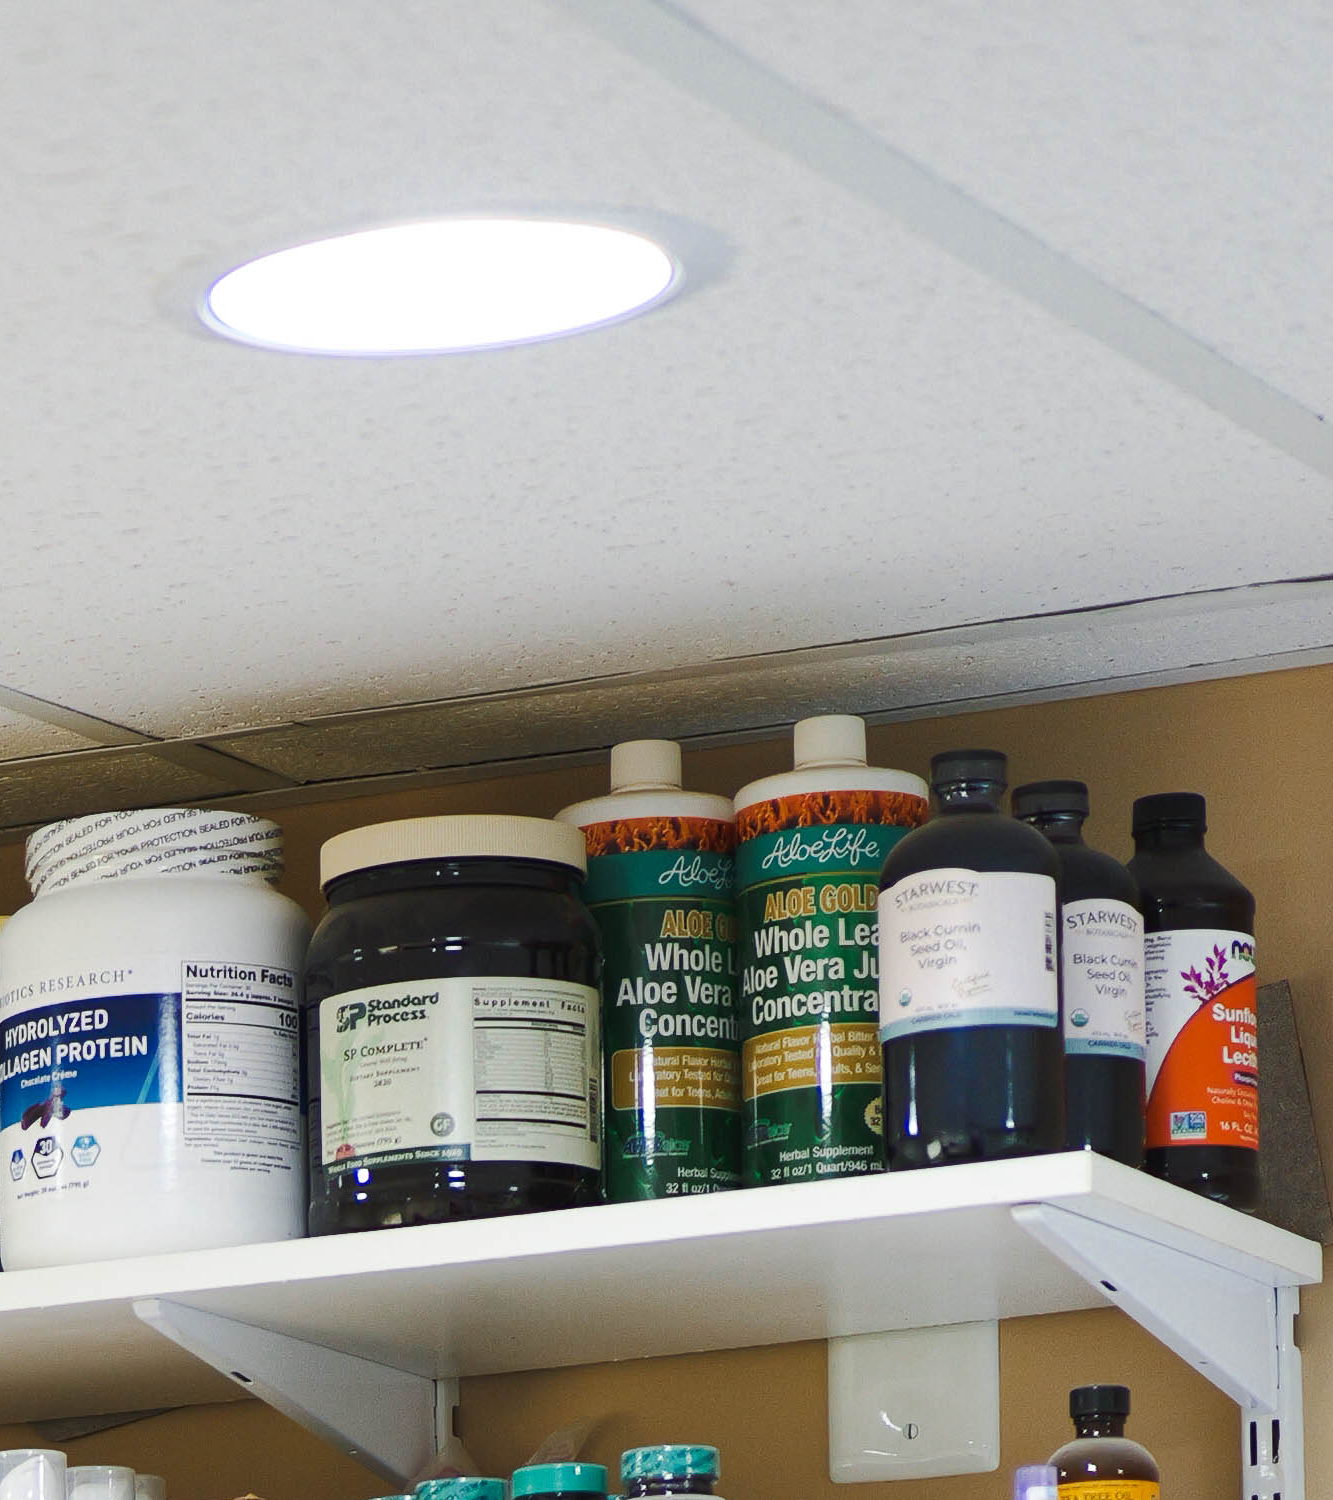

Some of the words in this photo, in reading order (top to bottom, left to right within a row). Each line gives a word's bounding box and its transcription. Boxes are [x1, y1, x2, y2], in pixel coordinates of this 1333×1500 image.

[764, 886, 816, 923] ALOE
[820, 883, 879, 913] GOLD
[895, 879, 979, 909] STARWEST
[661, 909, 714, 939] ALOE
[1066, 909, 1138, 930] STARWEST
[755, 917, 831, 956] Whole
[838, 923, 879, 948] Lea
[900, 926, 931, 944] Black
[933, 922, 981, 936] Cumin
[645, 943, 723, 972] Whole
[910, 941, 938, 957] Seed
[1072, 953, 1108, 966] Black
[918, 954, 958, 970] Virgin
[40, 970, 126, 994] RESEARCH
[186, 964, 256, 981] Nutrition
[260, 969, 293, 987] Facts
[742, 967, 778, 997] Aloe
[784, 955, 845, 984] Vera
[617, 977, 679, 1007] Aloe
[683, 973, 732, 1002] Vera
[1095, 985, 1127, 999] Virgin
[368, 992, 439, 1014] Standard
[752, 983, 879, 1025] Concentra
[186, 1011, 225, 1023] Calories
[278, 1012, 298, 1029] 100
[368, 1009, 428, 1026] Process
[5, 1009, 109, 1050] HYDROLYZED
[56, 1036, 148, 1067] PROTEIN
[343, 1049, 357, 1062] SP
[779, 1148, 810, 1162] Herbal
[812, 1142, 874, 1158] Supplement
[771, 1168, 782, 1179] 32
